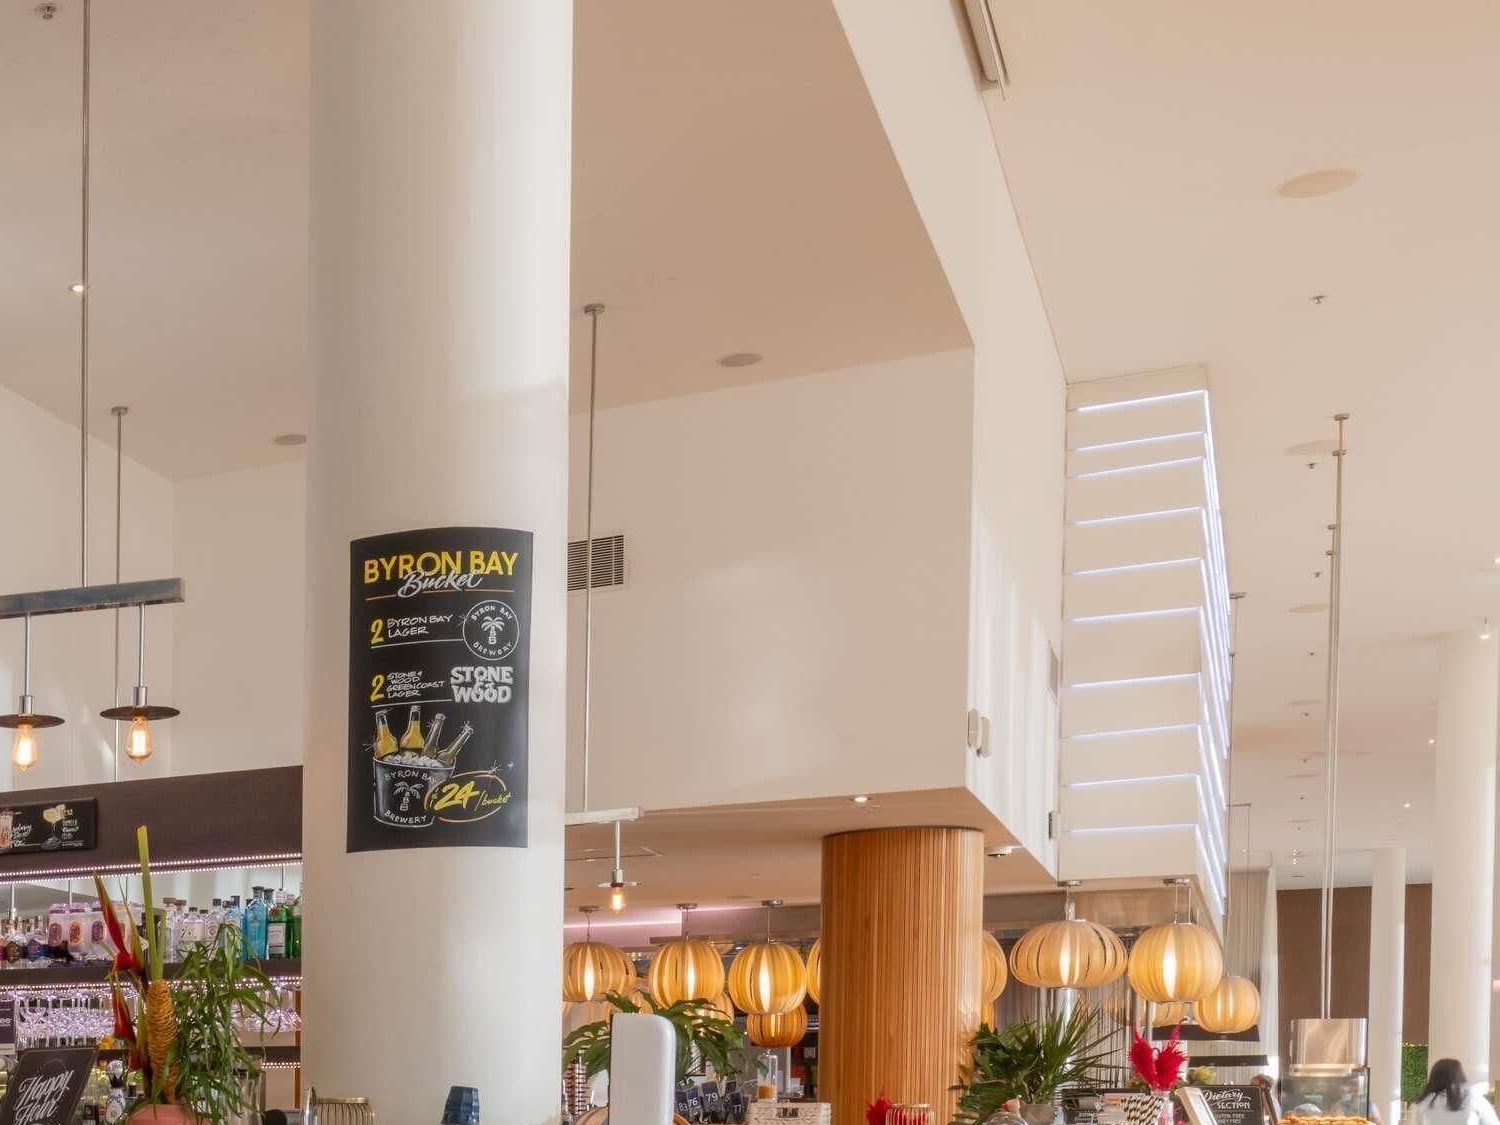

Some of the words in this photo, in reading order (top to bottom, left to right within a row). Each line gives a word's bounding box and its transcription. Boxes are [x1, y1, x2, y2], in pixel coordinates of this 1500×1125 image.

[364, 551, 462, 584] BYRON
[470, 551, 519, 576] BAY
[397, 569, 483, 598] Bucket
[370, 618, 385, 644] 2
[387, 616, 428, 628] BYRON
[429, 614, 453, 623] BAY
[388, 626, 429, 638] LAGER
[450, 666, 514, 685] STONE
[370, 674, 385, 702] 2
[451, 685, 512, 704] WOOD
[384, 769, 419, 782] BYRON
[384, 810, 427, 824] BREWERY
[13, 1070, 75, 1111] Happy
[705, 1092, 718, 1103] 79
[1202, 1088, 1252, 1102] Dietary
[678, 1102, 688, 1112] 83
[688, 1097, 698, 1106] 76
[1217, 1101, 1250, 1109] SECTION
